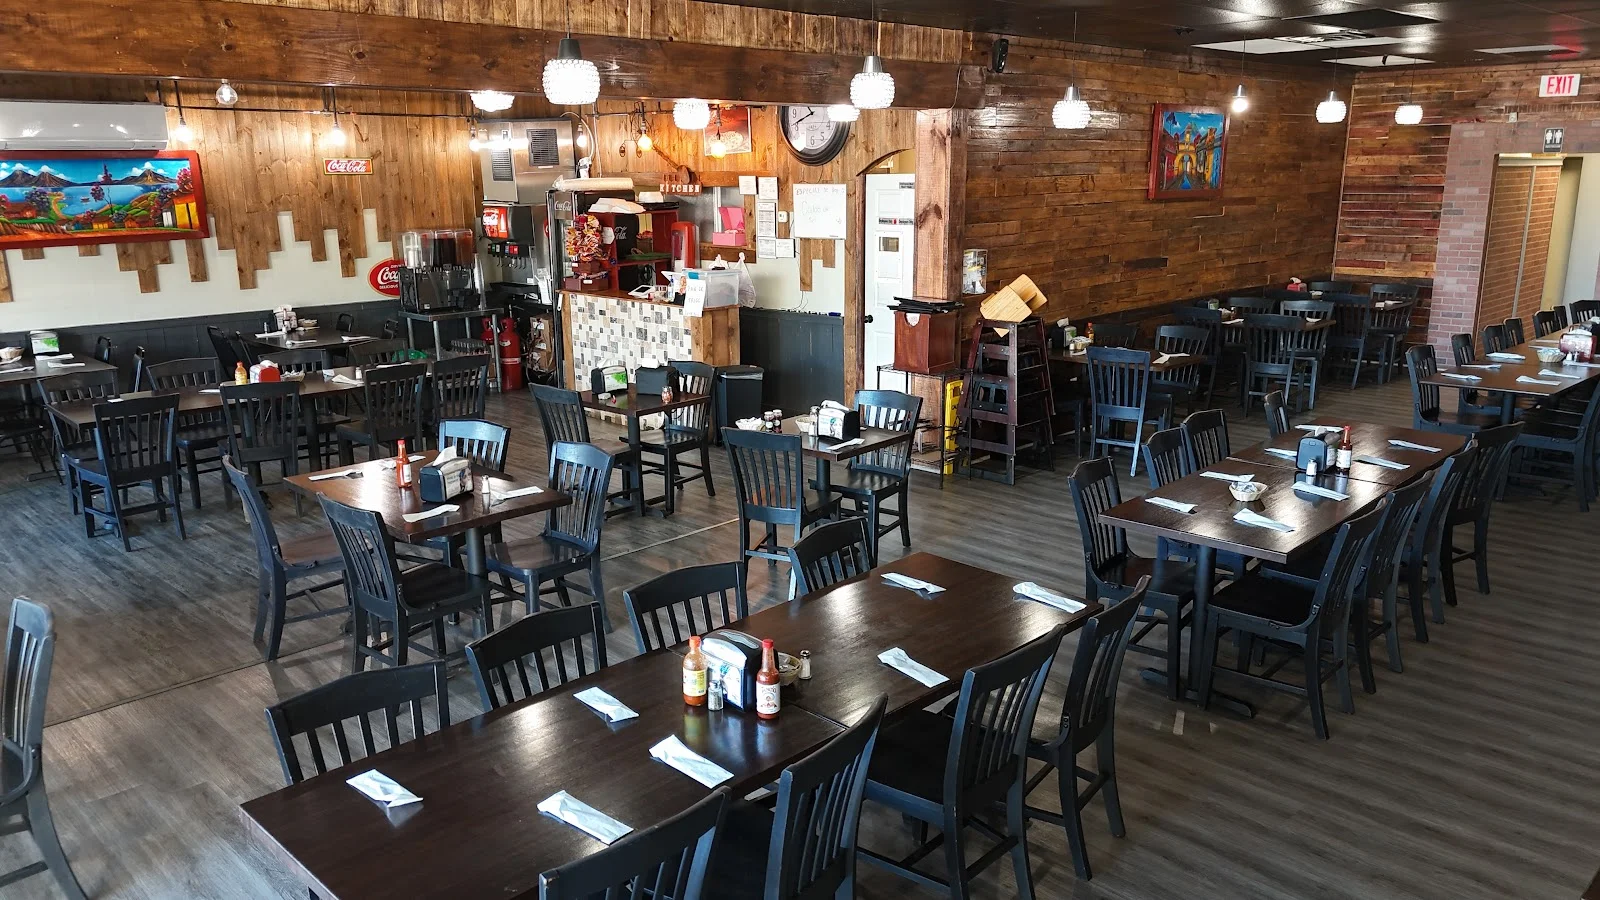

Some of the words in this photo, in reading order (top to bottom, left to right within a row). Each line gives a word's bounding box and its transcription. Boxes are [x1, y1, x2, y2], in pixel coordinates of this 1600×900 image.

[1546, 76, 1574, 94] EXIT
[792, 109, 797, 118] 9
[826, 120, 831, 130] 4
[810, 136, 815, 145] 6
[820, 132, 825, 141] 5
[660, 183, 700, 193] KITCHEN
